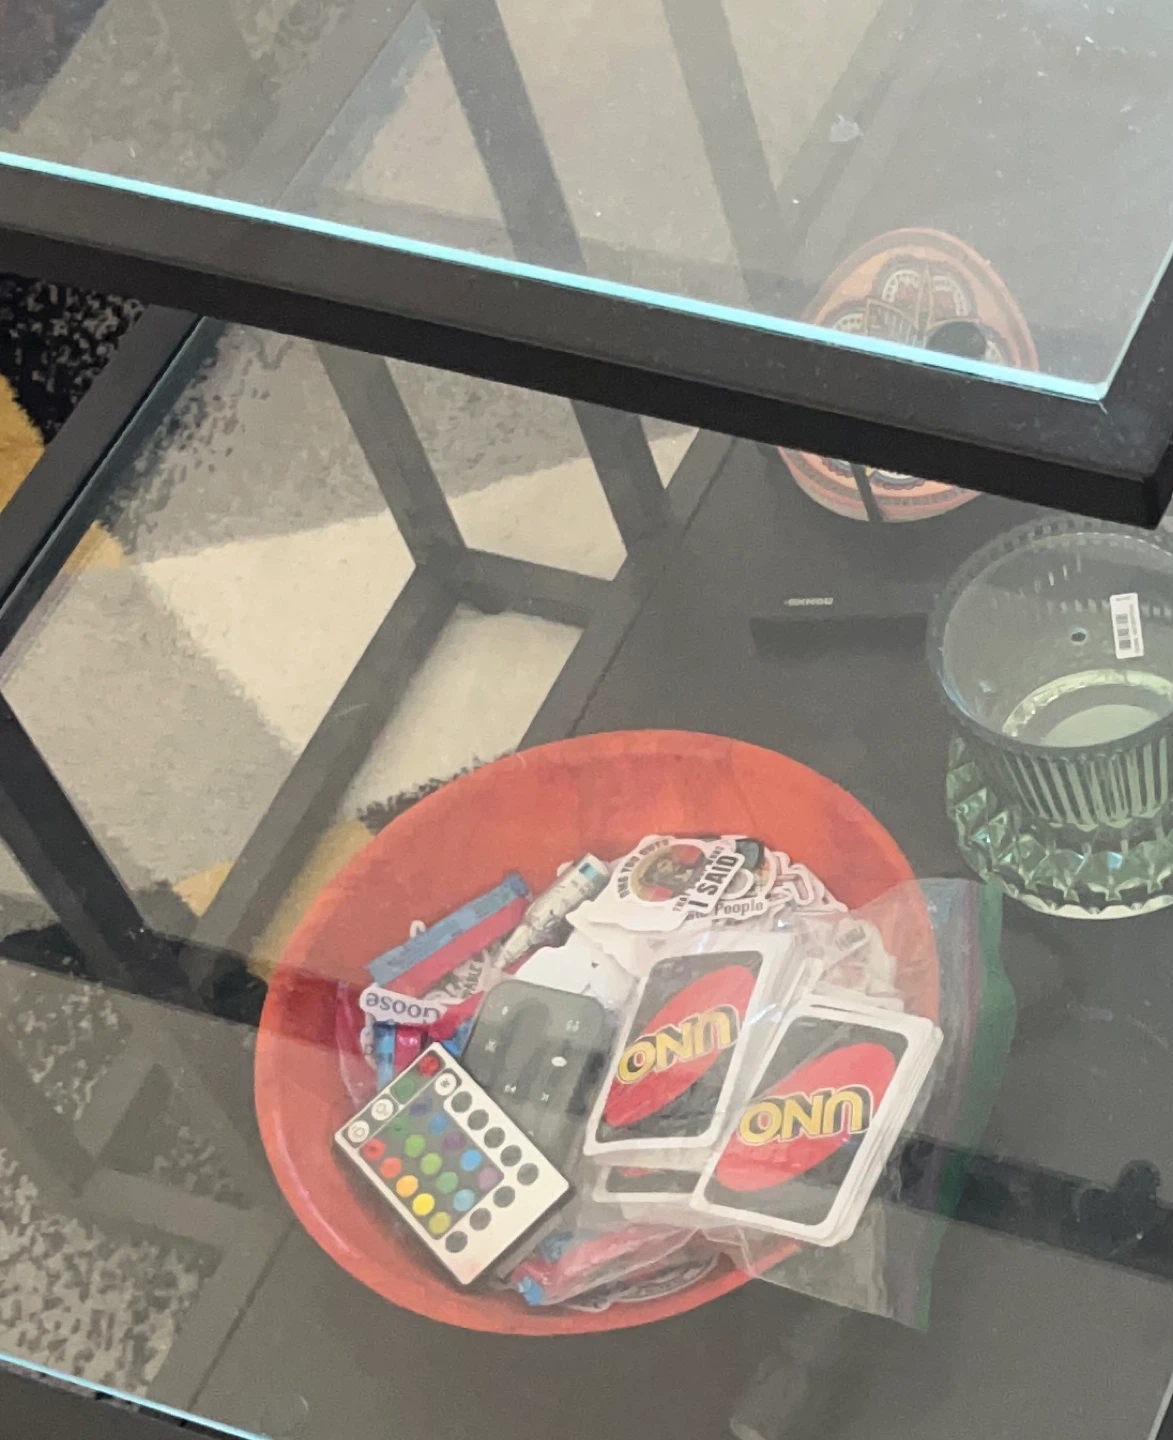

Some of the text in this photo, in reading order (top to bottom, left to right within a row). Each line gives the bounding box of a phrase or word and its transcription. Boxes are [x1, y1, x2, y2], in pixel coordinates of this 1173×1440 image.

[696, 854, 740, 897] SAID
[714, 898, 765, 917] People
[616, 1003, 742, 1086] UNO
[737, 1084, 873, 1147] UNO
